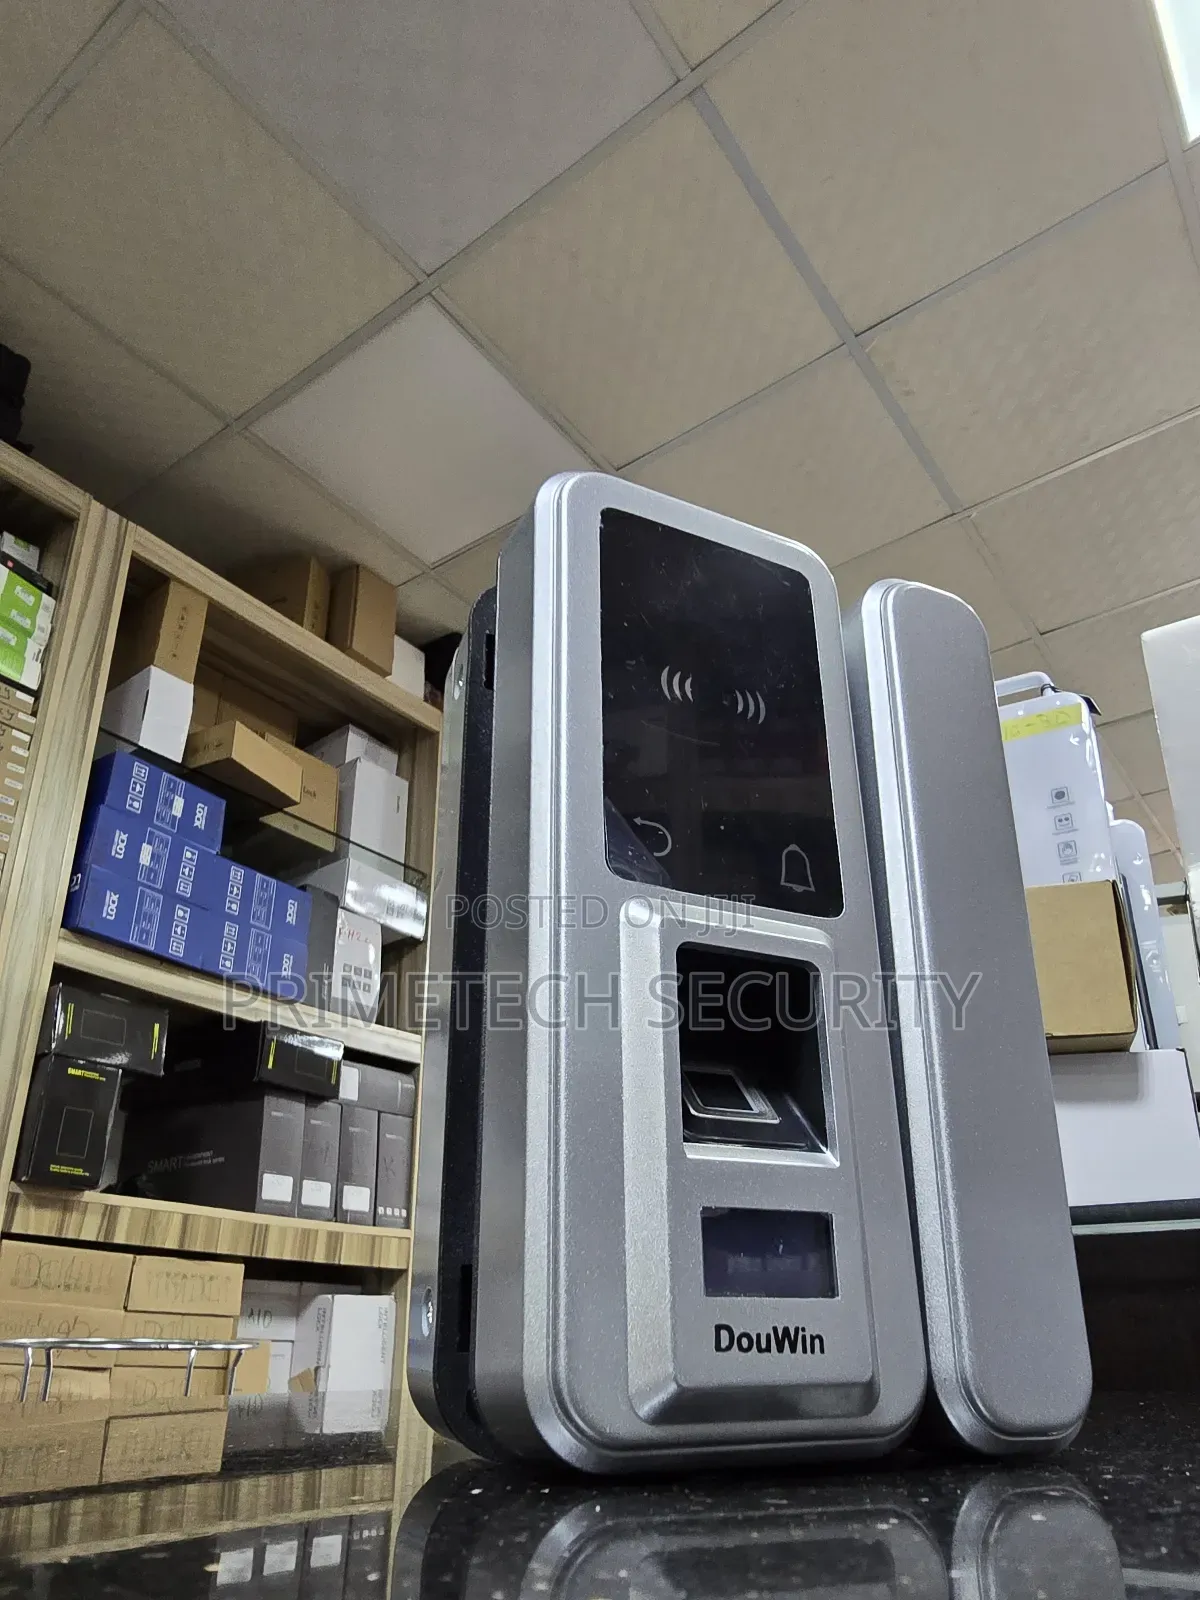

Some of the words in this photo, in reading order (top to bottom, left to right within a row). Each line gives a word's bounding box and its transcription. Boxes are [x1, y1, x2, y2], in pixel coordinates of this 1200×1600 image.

[194, 802, 205, 831] LOCK
[115, 831, 129, 860] LOCK
[106, 891, 120, 920] LOCK
[147, 1156, 184, 1174] SMART
[713, 1323, 826, 1355] DouWin
